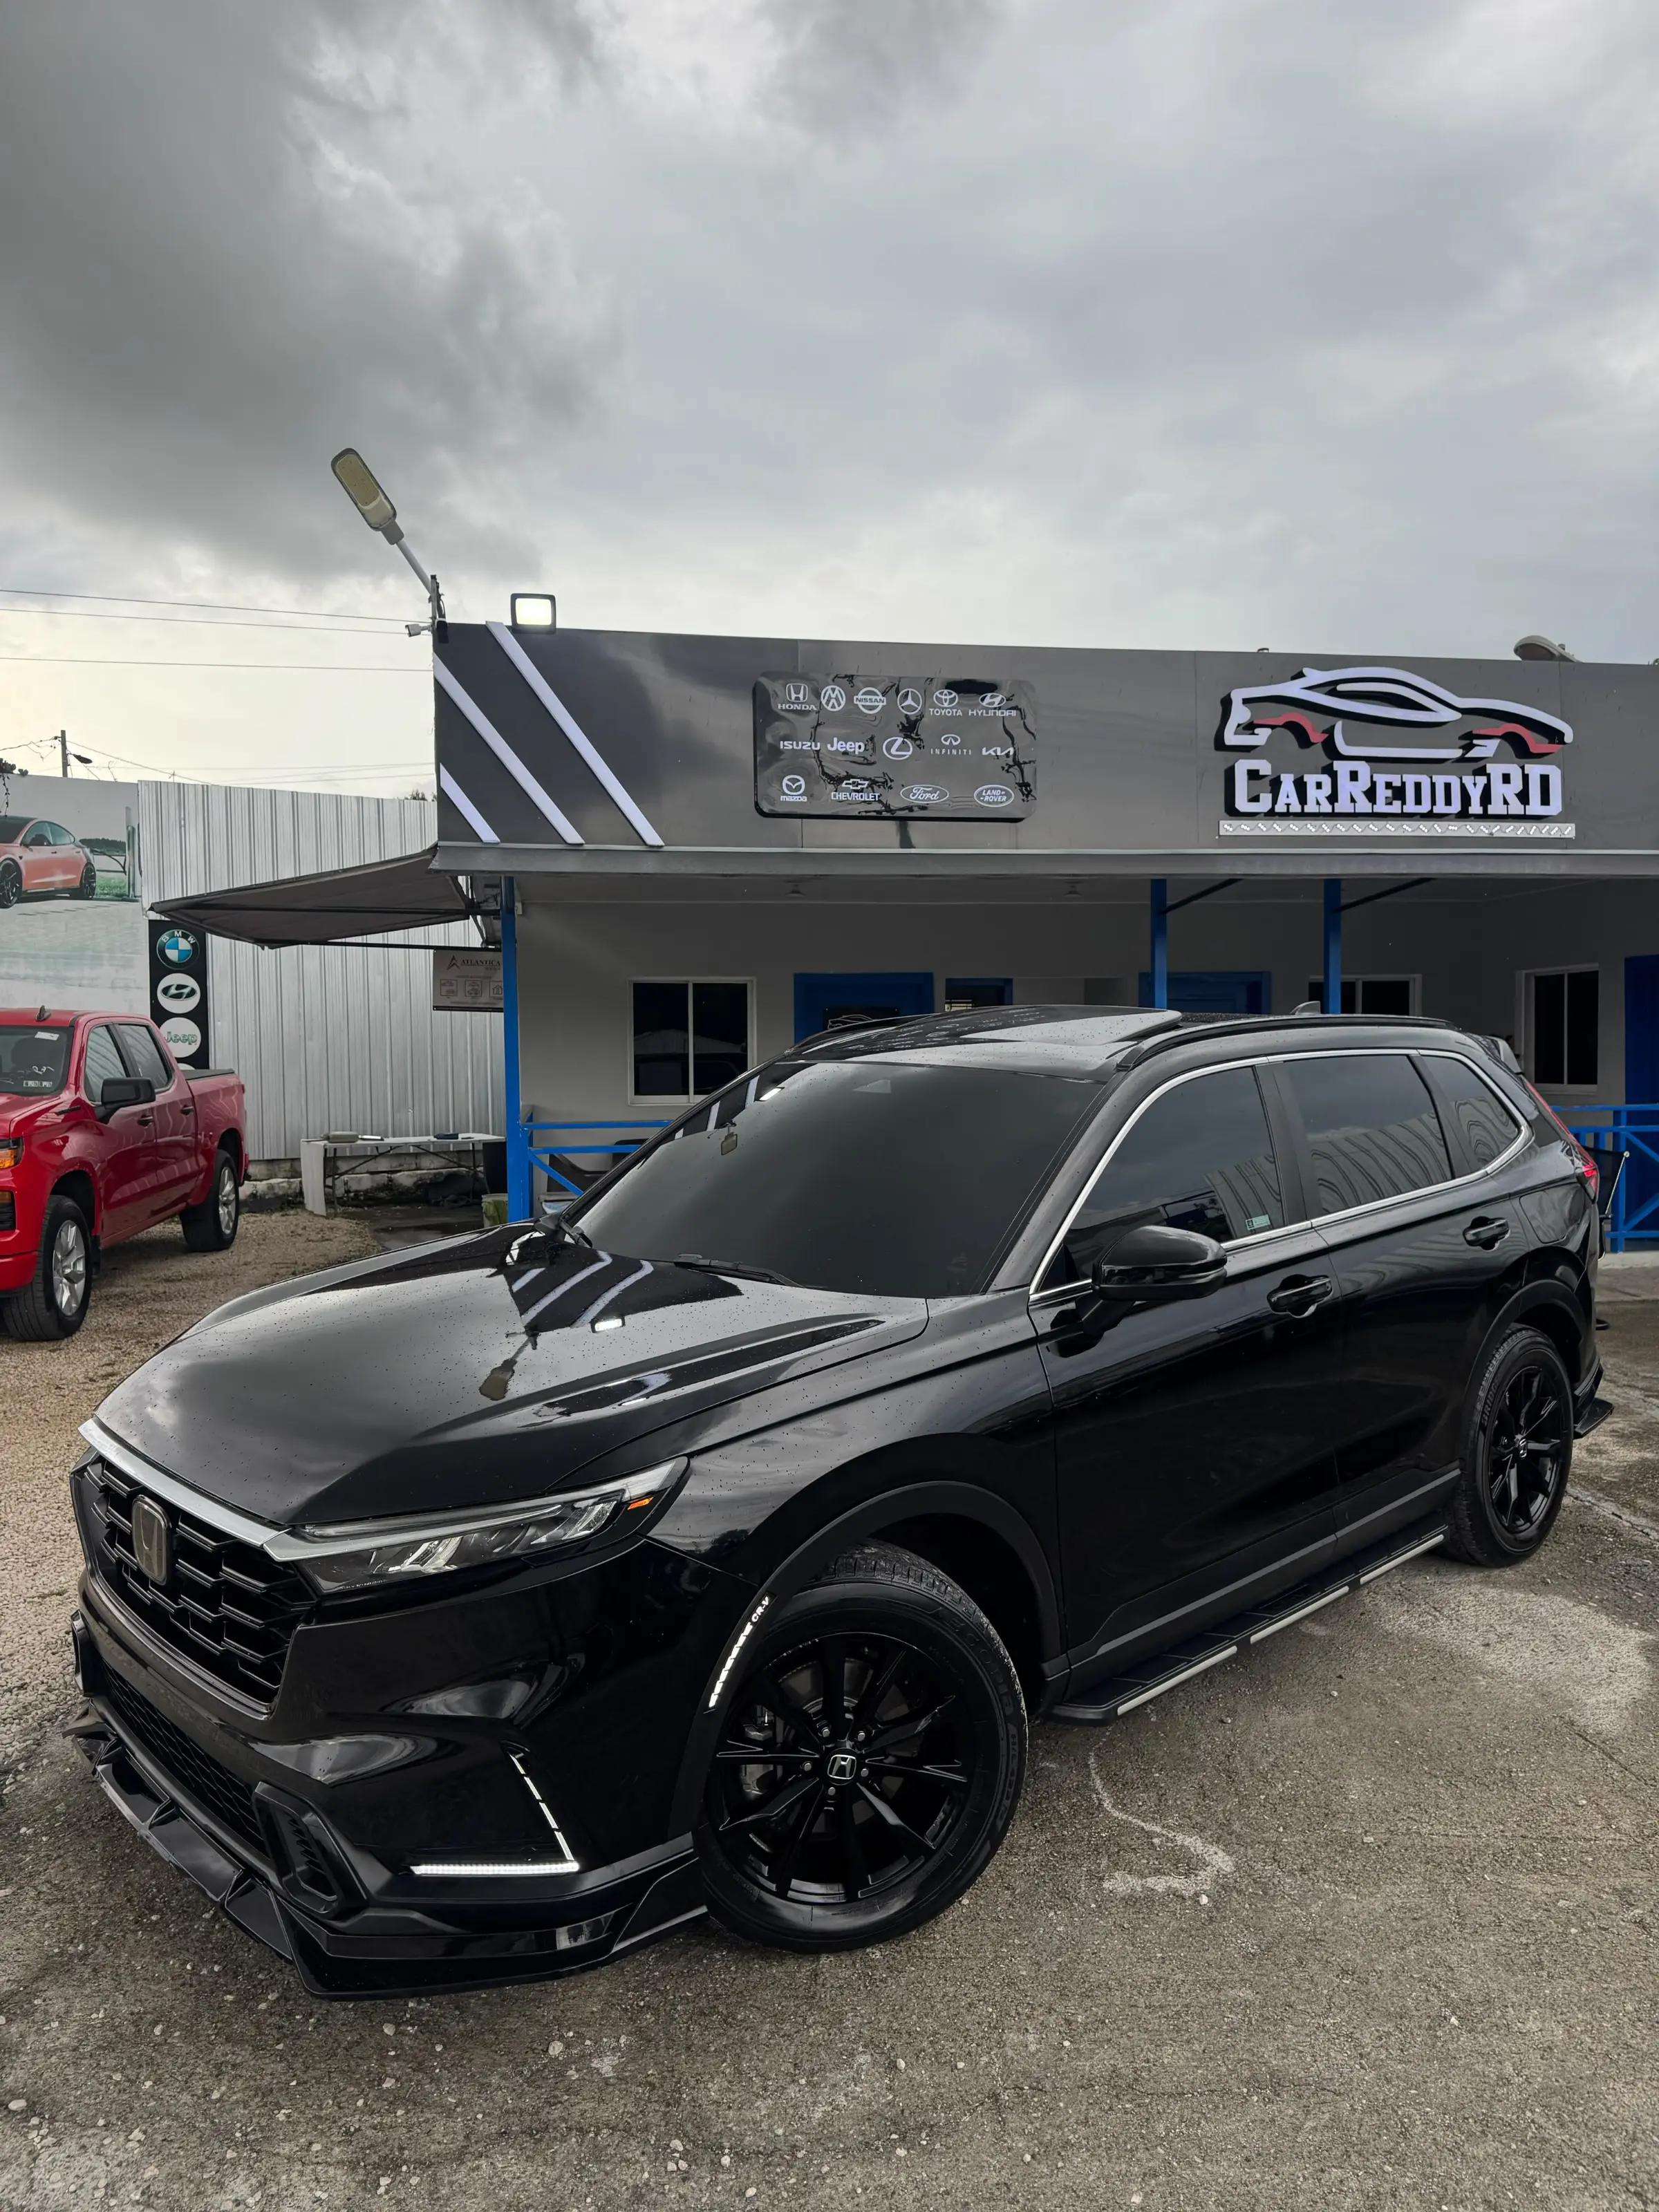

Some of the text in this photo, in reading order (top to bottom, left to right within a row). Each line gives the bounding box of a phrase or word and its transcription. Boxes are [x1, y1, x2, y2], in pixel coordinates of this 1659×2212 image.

[929, 708, 963, 716] TOYOTA
[780, 740, 821, 751] ISUZU
[827, 737, 865, 755] Jeep
[831, 792, 880, 801] CHEVROLET
[910, 786, 940, 800] Ford
[161, 930, 196, 944] BMW
[164, 1031, 198, 1045] Jeep
[751, 1596, 769, 1622] CR-V
